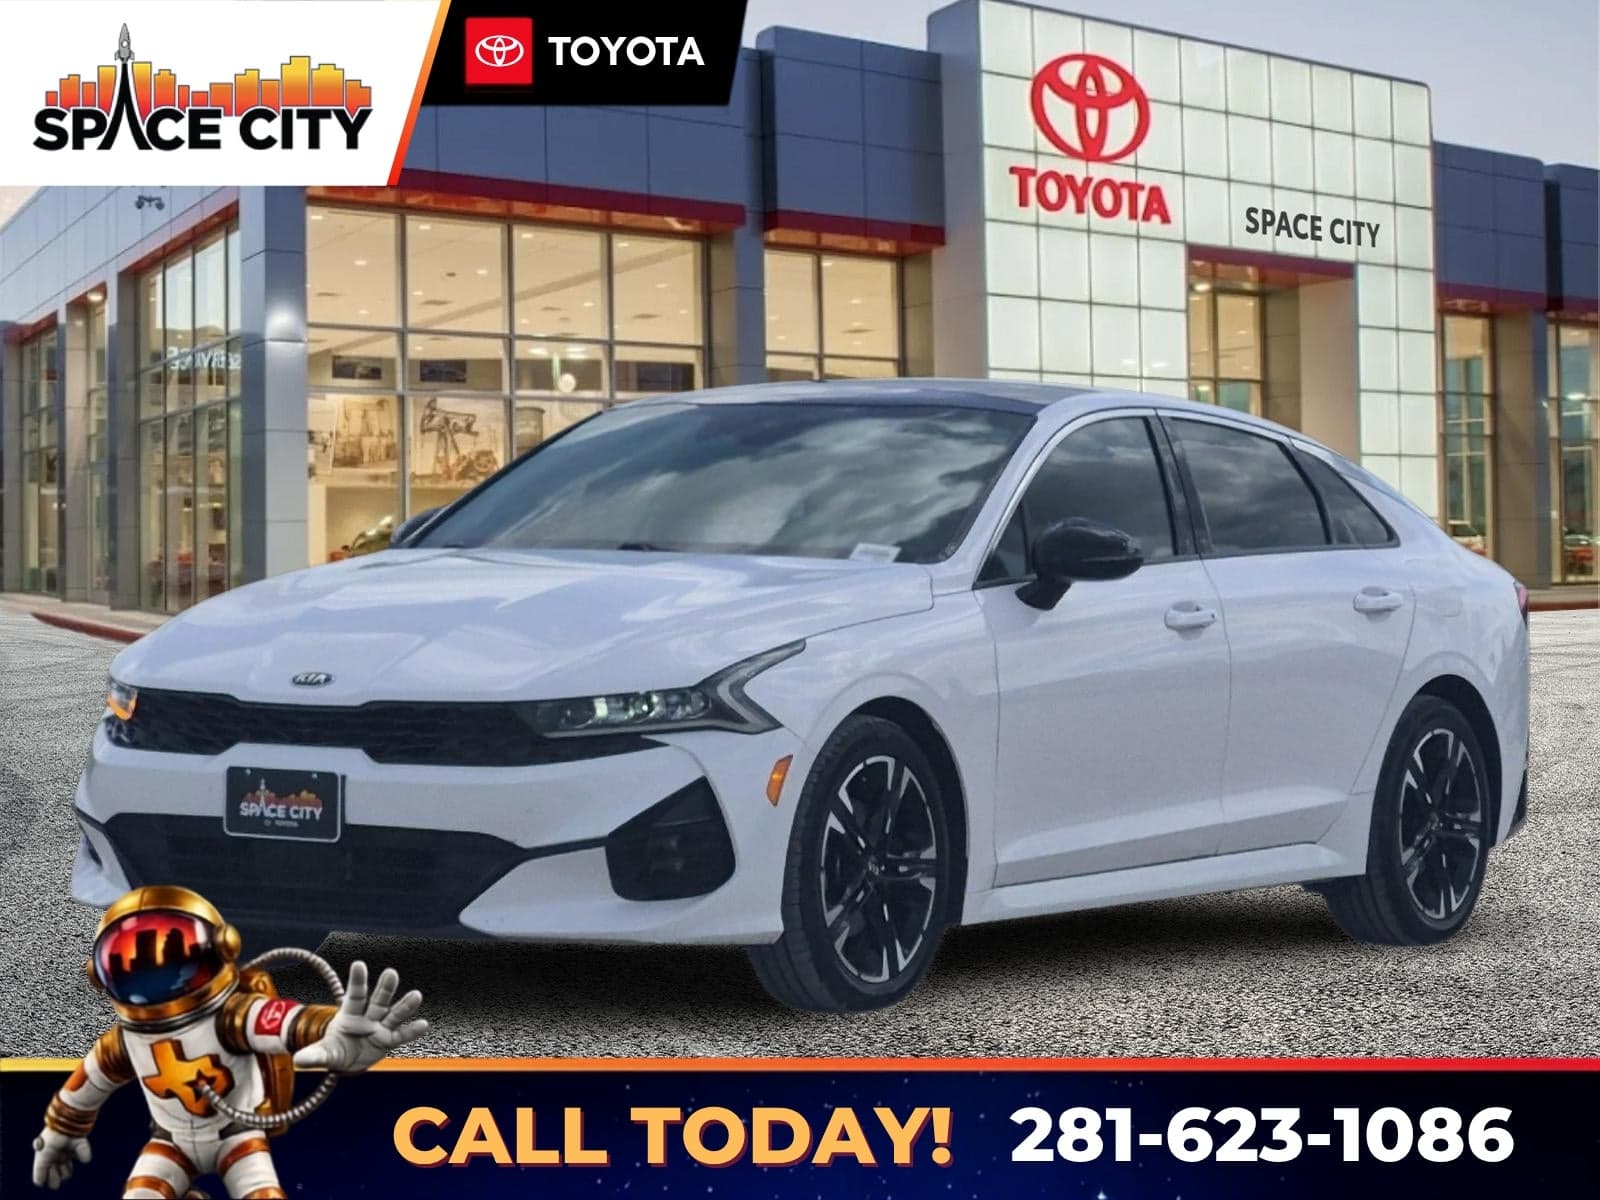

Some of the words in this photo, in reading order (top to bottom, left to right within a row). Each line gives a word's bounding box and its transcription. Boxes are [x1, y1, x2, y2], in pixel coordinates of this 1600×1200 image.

[1009, 166, 1171, 225] TOYOTA
[1245, 207, 1322, 242] SPACE
[1329, 218, 1380, 248] CITY
[294, 672, 330, 686] KIA
[240, 802, 287, 818] SPACE
[289, 806, 323, 821] CITY
